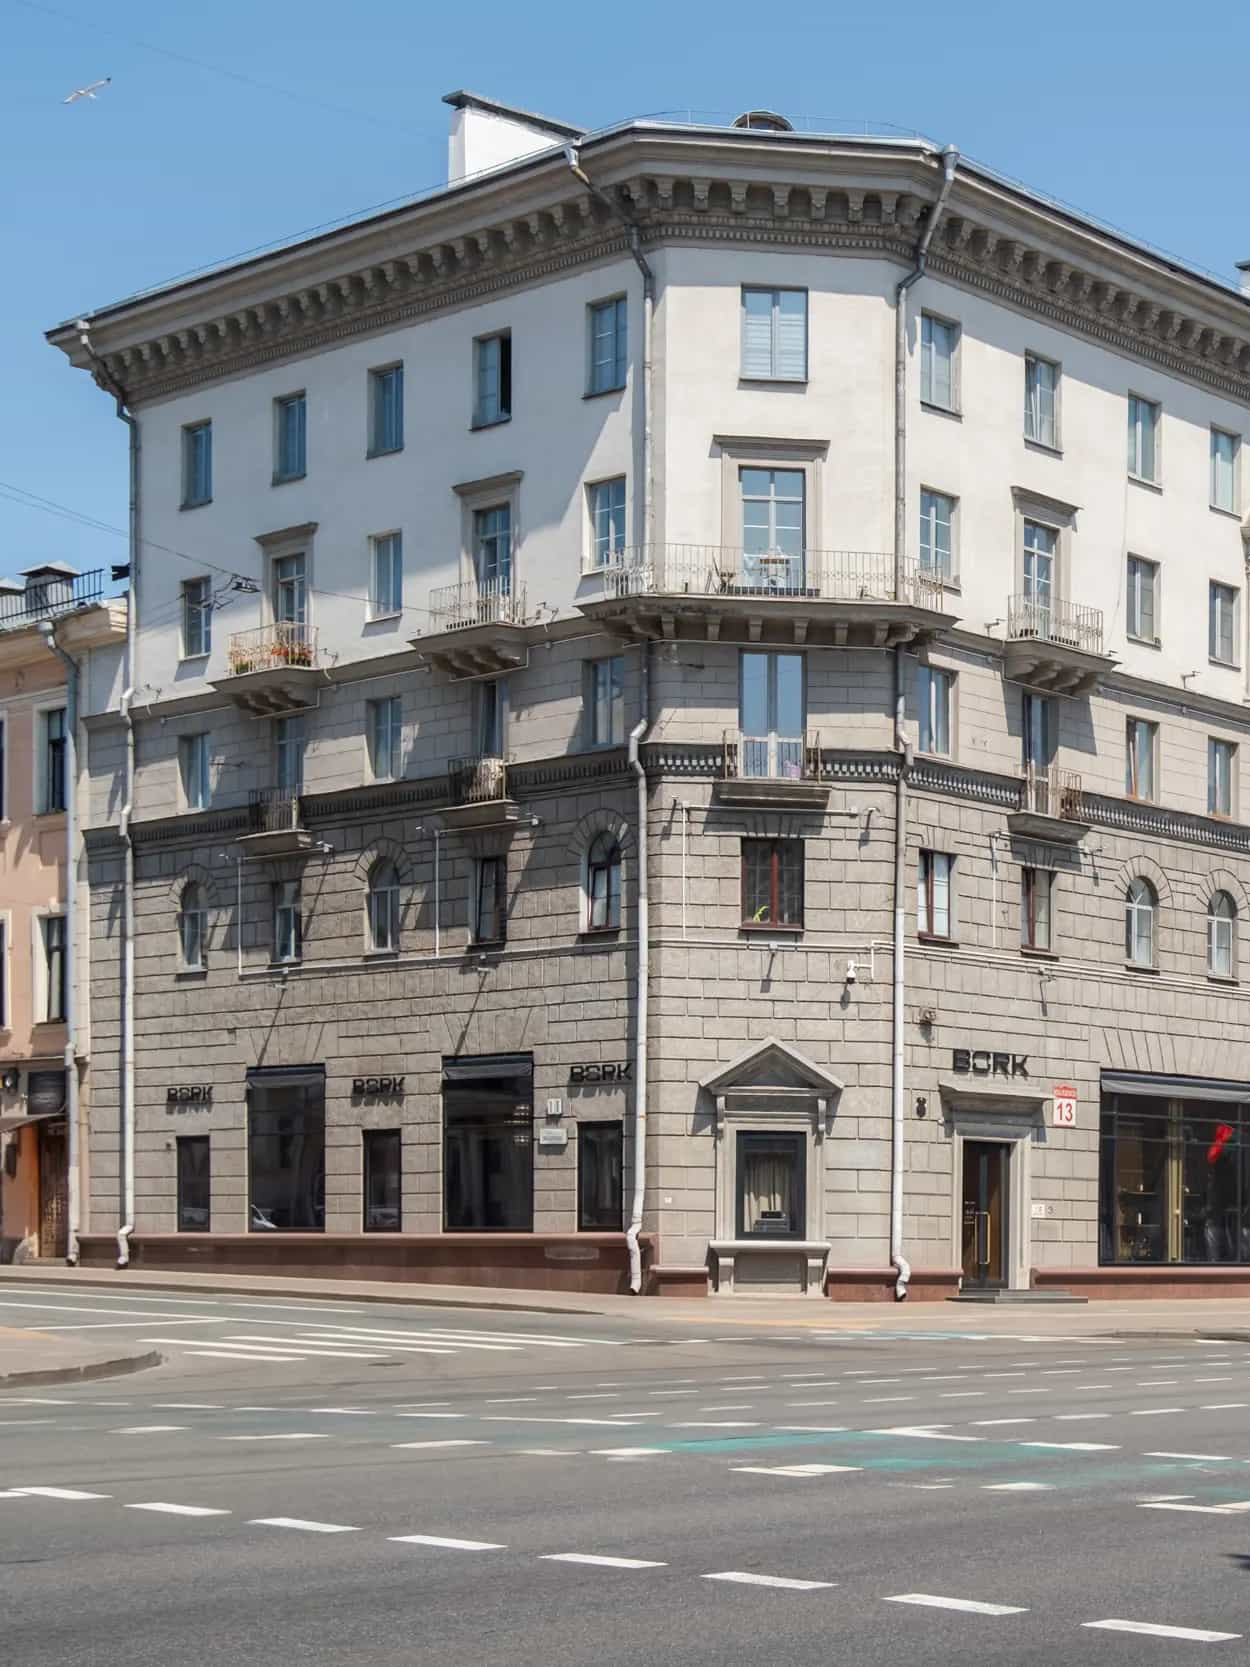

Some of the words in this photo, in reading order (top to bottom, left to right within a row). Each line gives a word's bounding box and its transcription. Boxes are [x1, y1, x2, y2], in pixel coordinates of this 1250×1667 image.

[953, 1048, 1029, 1077] BORK
[569, 1063, 632, 1082] BORK
[167, 1086, 213, 1104] BORK
[352, 1077, 406, 1096] BORK
[1057, 1103, 1073, 1121] 13
